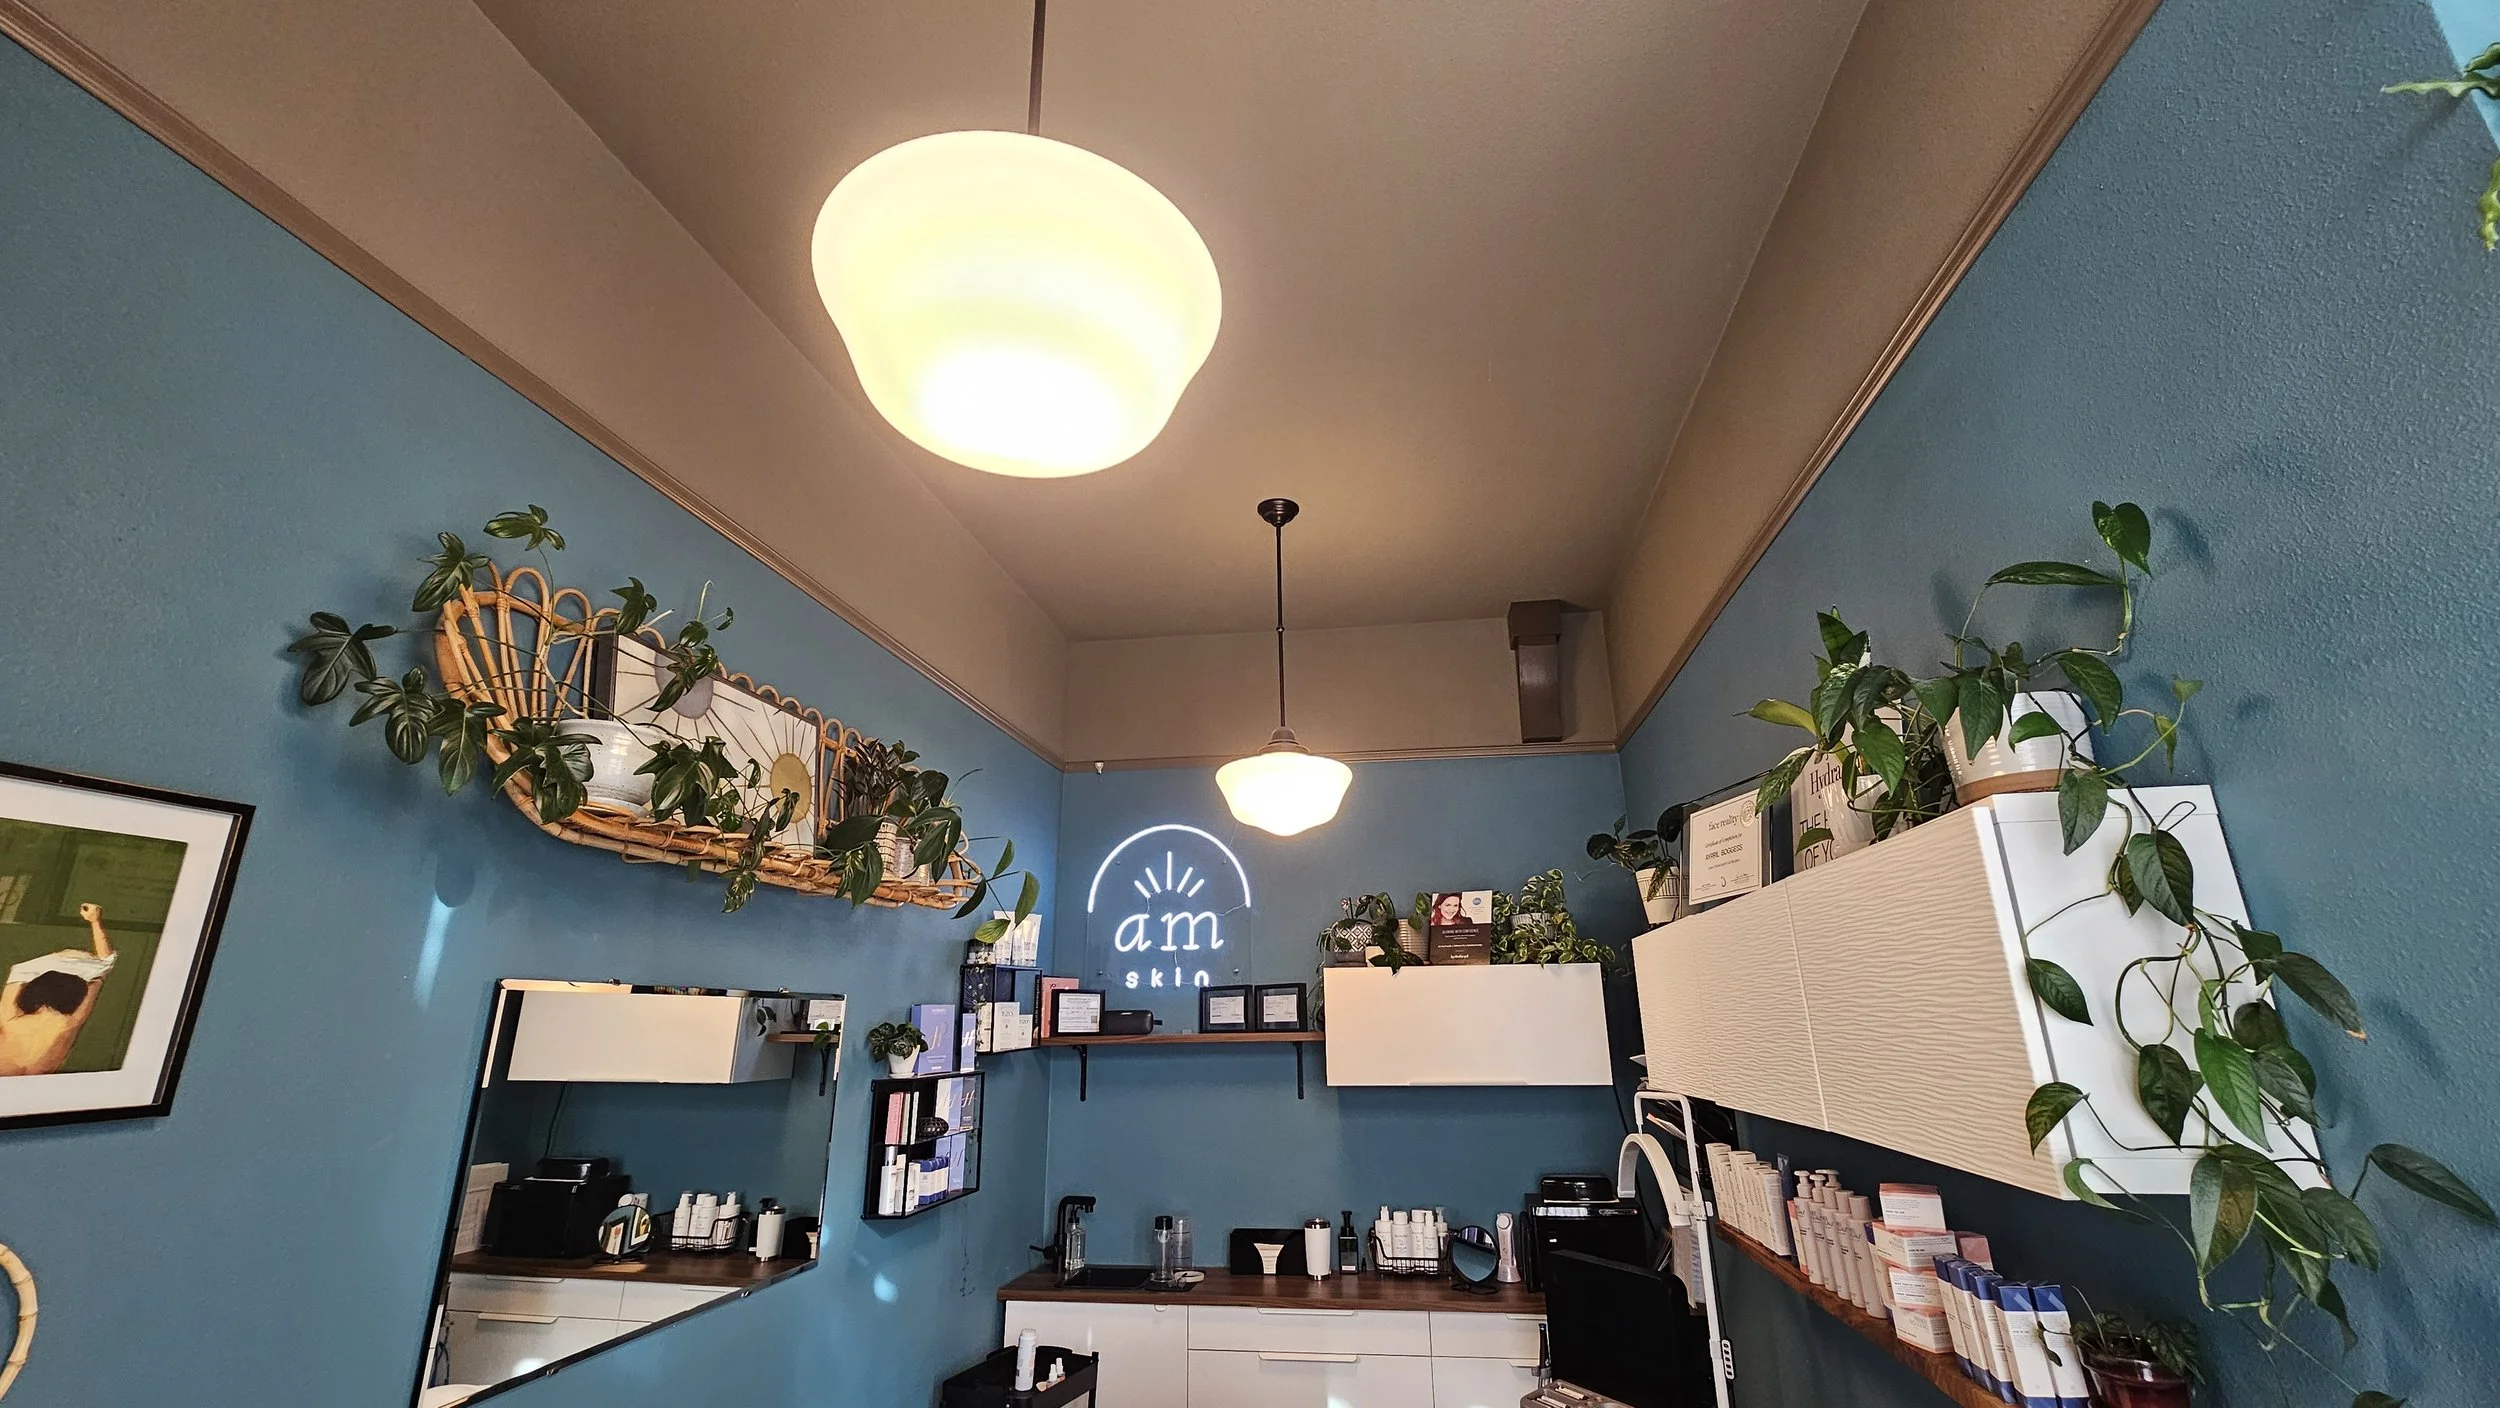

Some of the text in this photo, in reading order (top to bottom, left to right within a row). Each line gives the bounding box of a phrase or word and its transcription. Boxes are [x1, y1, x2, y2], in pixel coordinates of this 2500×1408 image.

[1804, 845, 1819, 870] OF
[1114, 911, 1225, 952] am
[1125, 966, 1210, 989] skin
